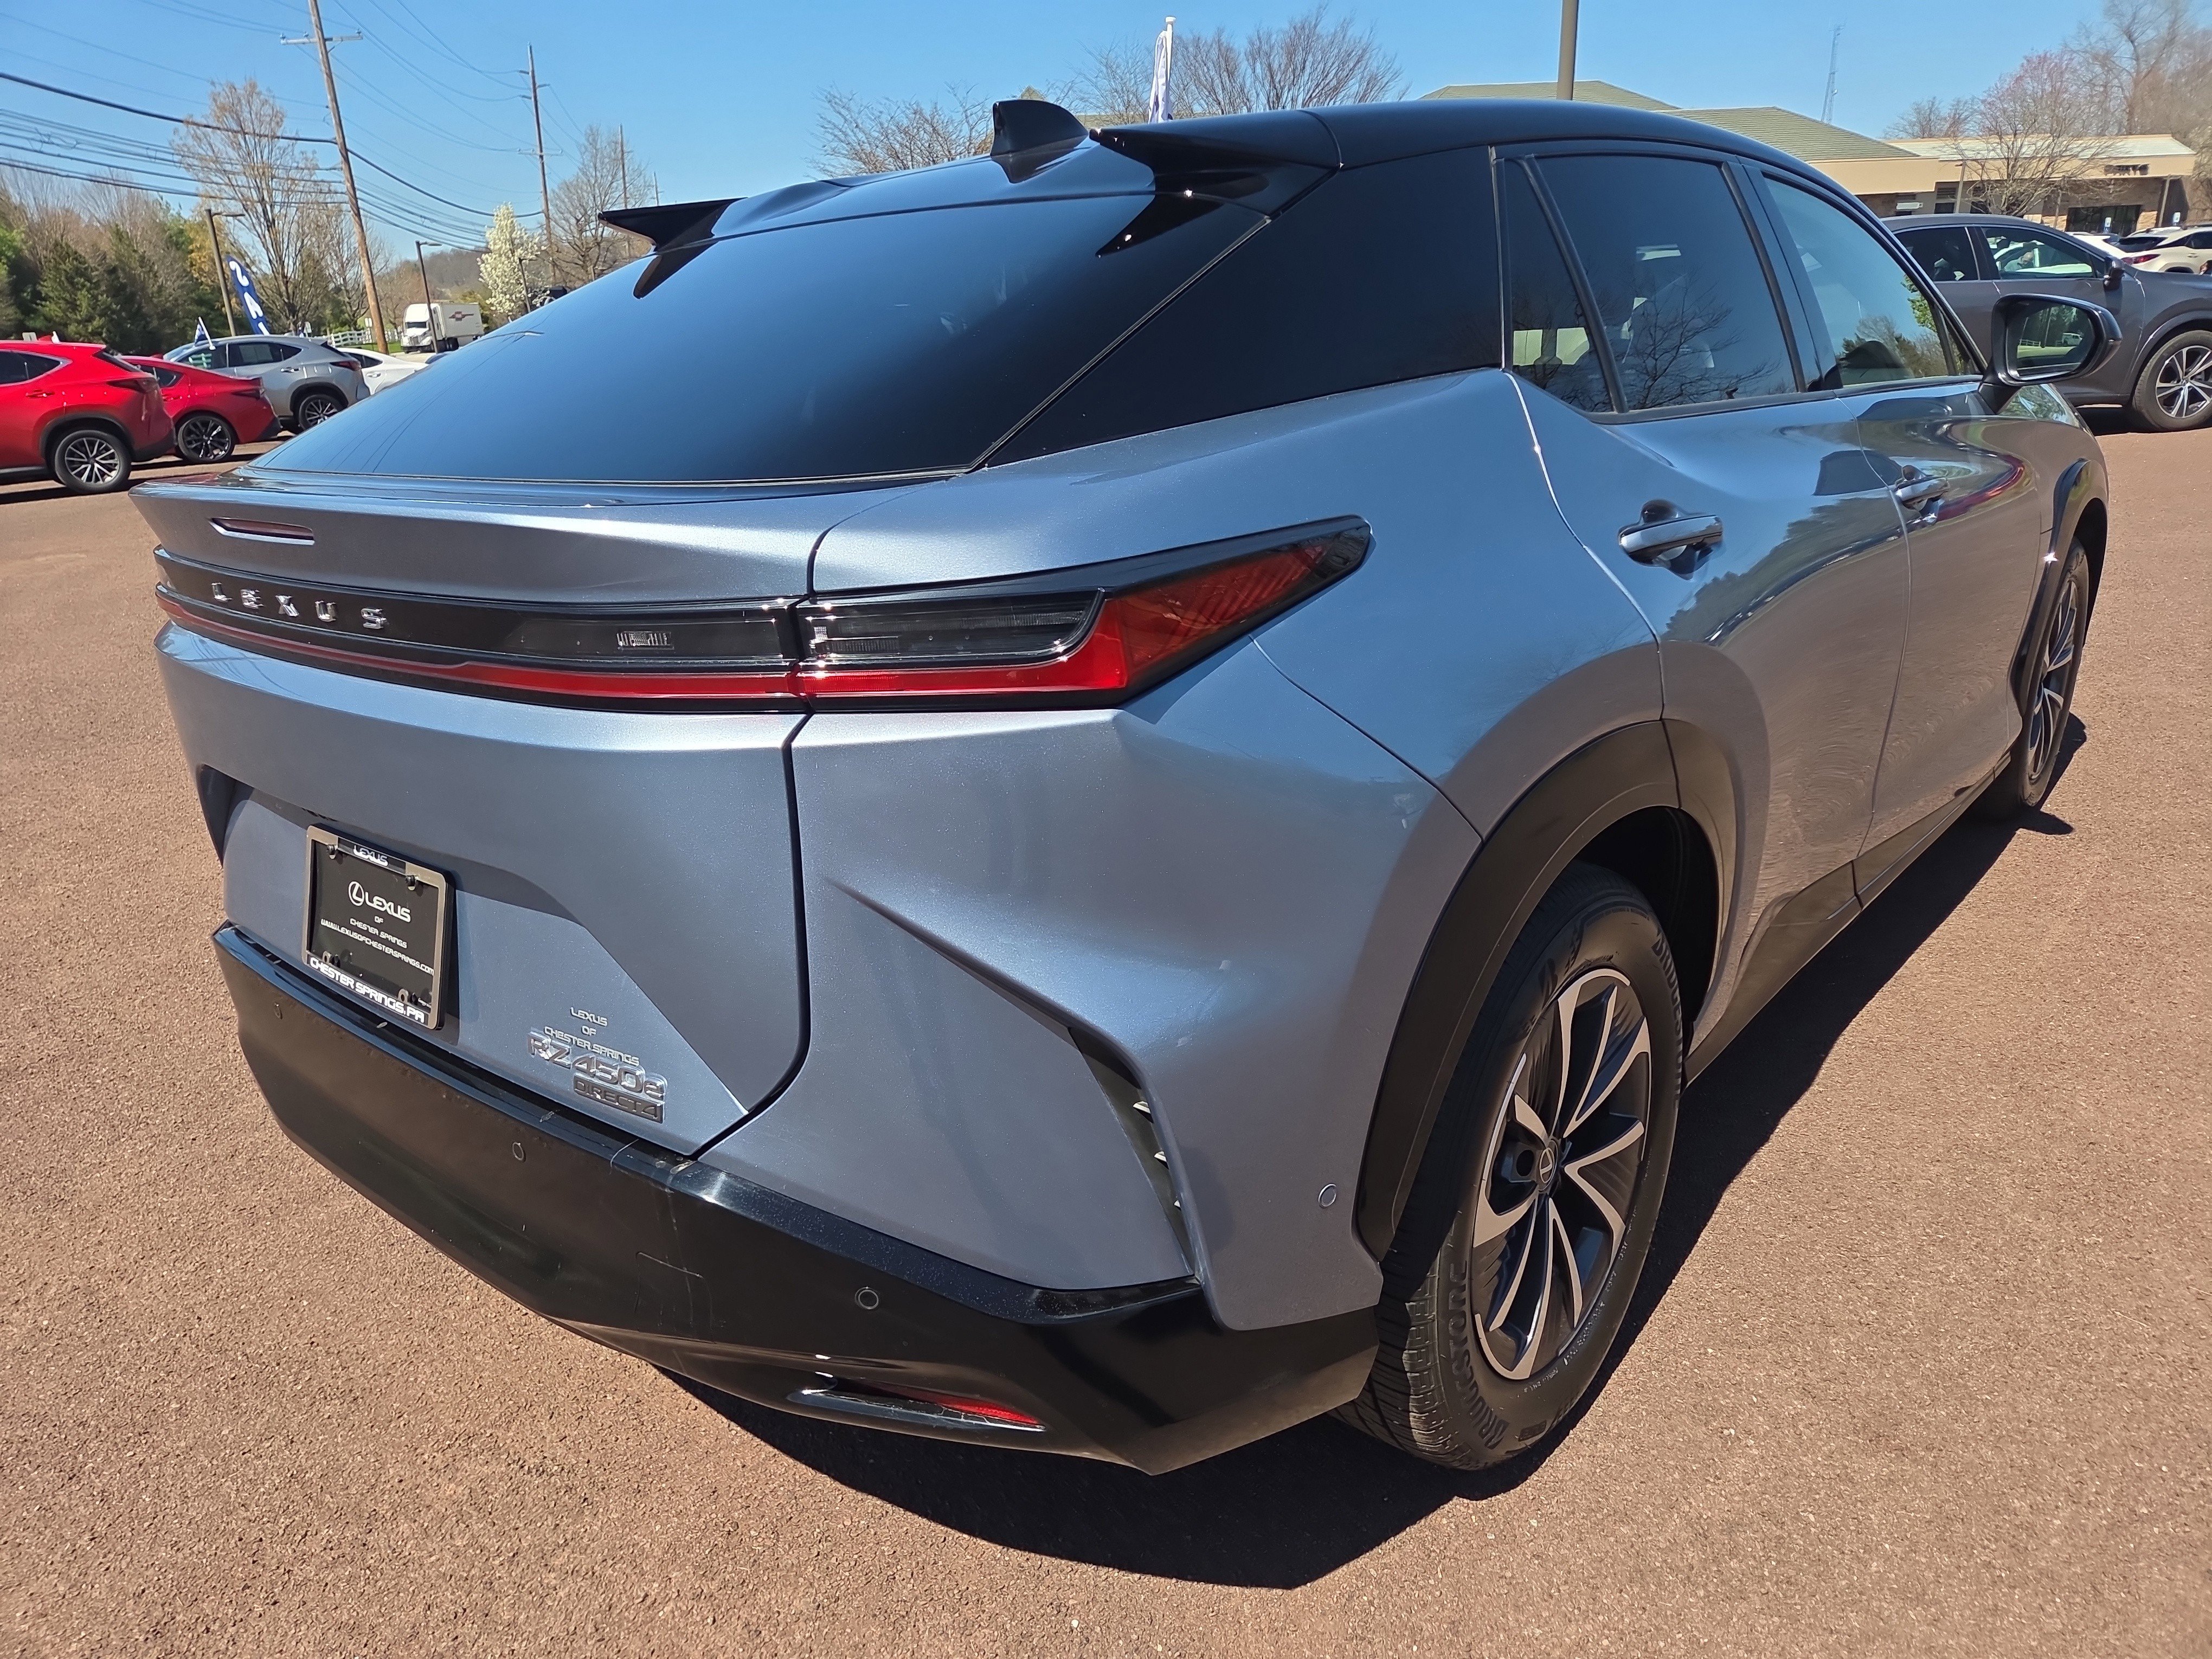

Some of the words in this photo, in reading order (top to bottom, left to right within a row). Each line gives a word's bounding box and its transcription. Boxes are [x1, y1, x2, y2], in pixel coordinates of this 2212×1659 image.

[211, 581, 386, 629] LEXUS
[353, 845, 388, 866] LEXUS
[365, 891, 411, 923] LEXUS
[350, 918, 379, 936] CHESTER
[379, 931, 407, 949] SPRINGS
[310, 957, 355, 989] CHESTER
[571, 1007, 608, 1026] LEXUS
[582, 1025, 597, 1036] OF
[528, 1031, 571, 1070] RZ
[544, 1026, 591, 1050] CHESTER
[591, 1043, 639, 1066] SPRINGS
[1448, 1259, 1510, 1451] BRIDGESTONE
